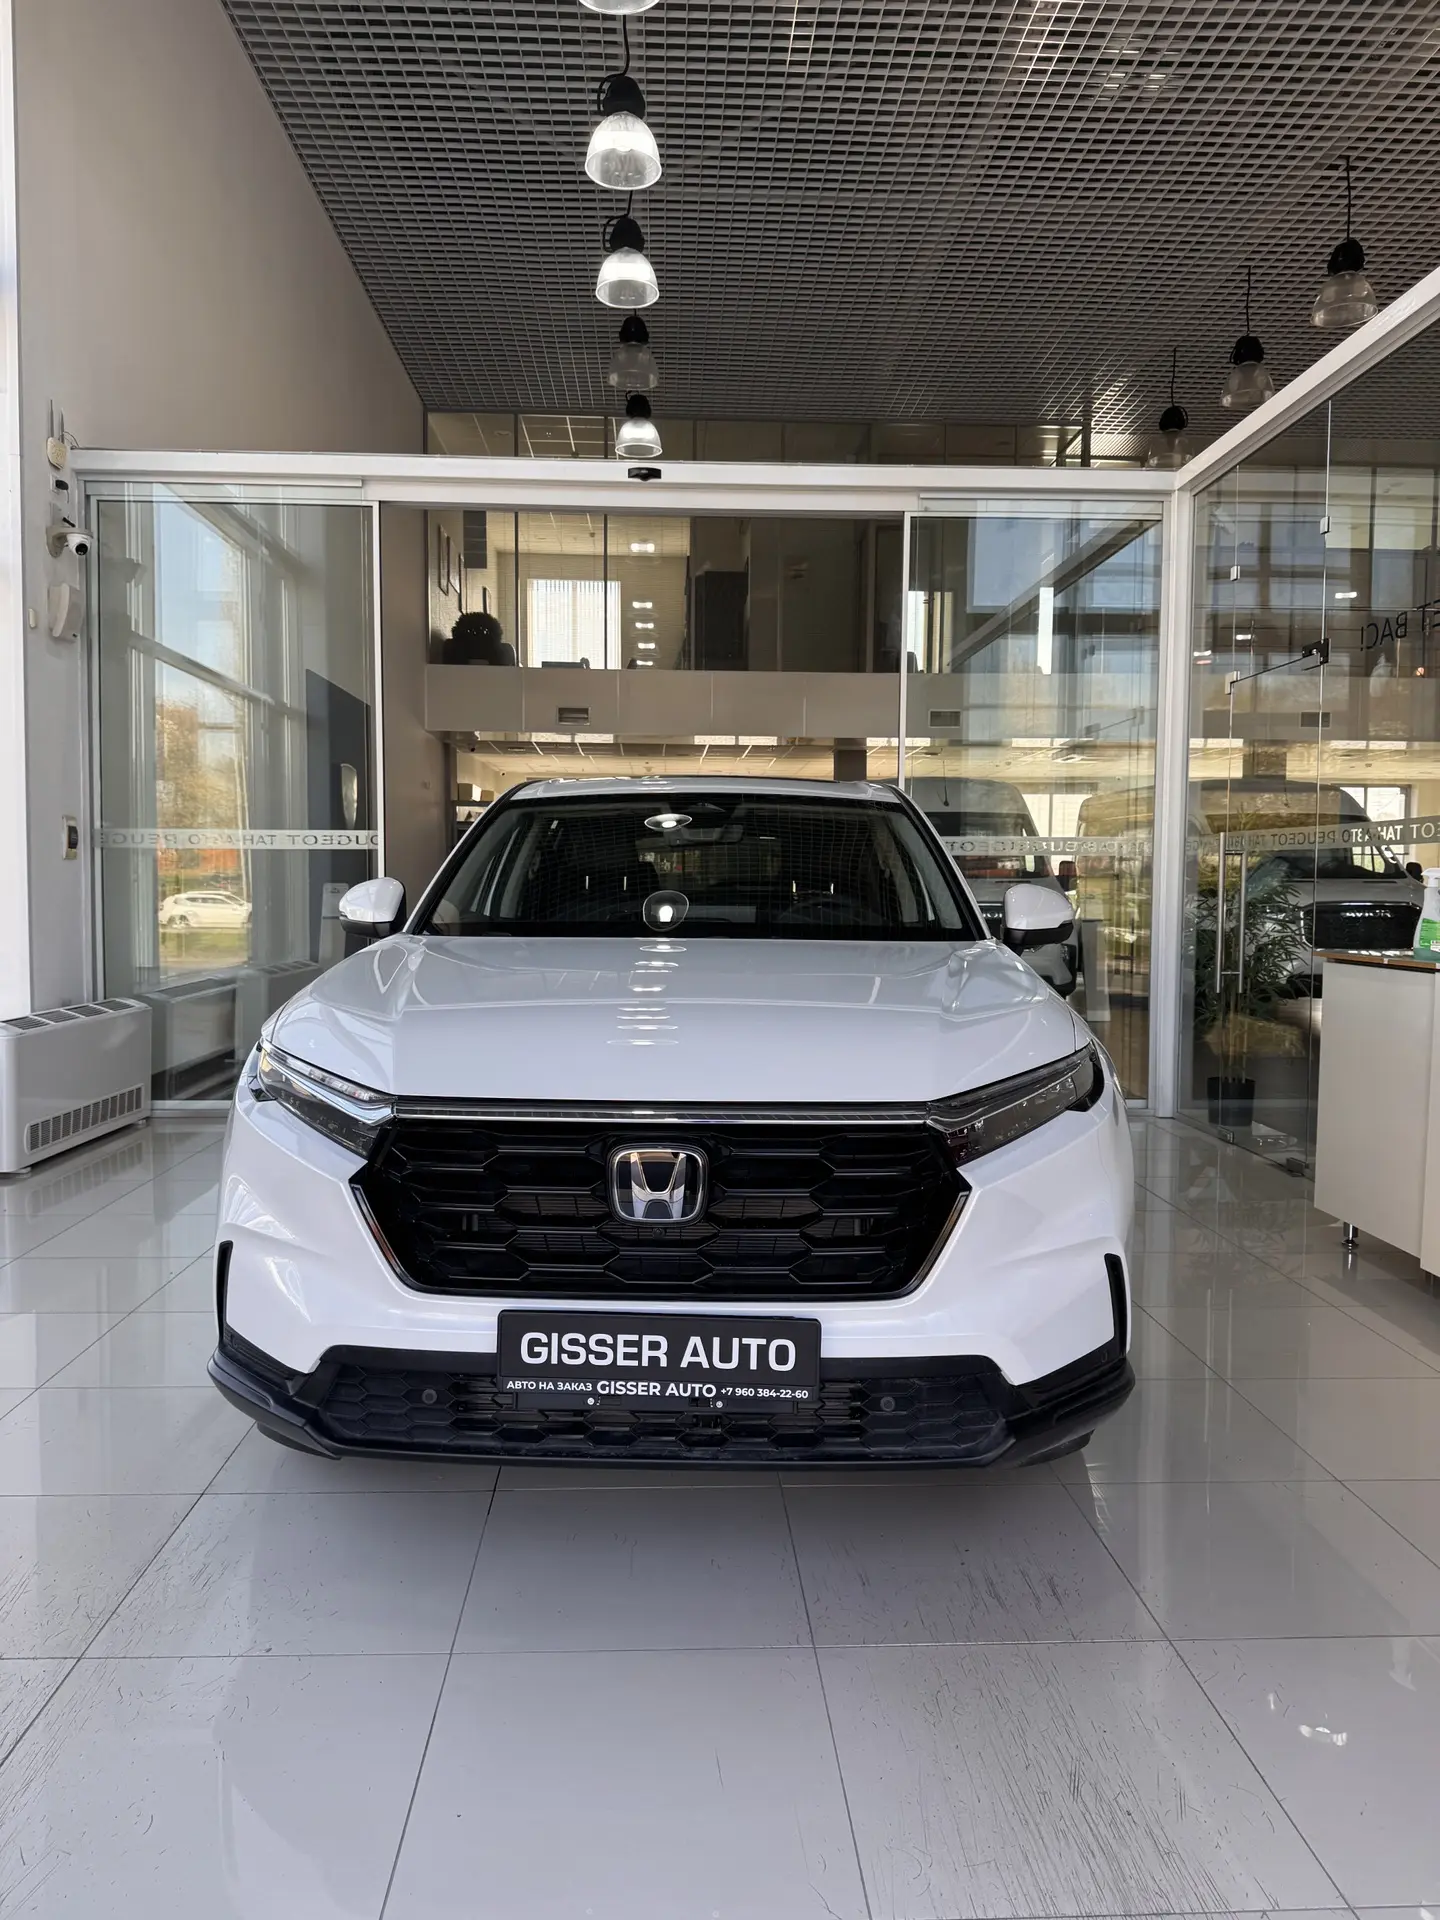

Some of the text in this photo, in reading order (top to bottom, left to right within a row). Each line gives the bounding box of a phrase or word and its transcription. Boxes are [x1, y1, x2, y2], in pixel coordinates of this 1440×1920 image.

[520, 1331, 796, 1372] GISSER AUTO
[506, 1380, 809, 1399] АВТО НА ЗАКАЗ GISSER AUTO +7 960 384-22-60
